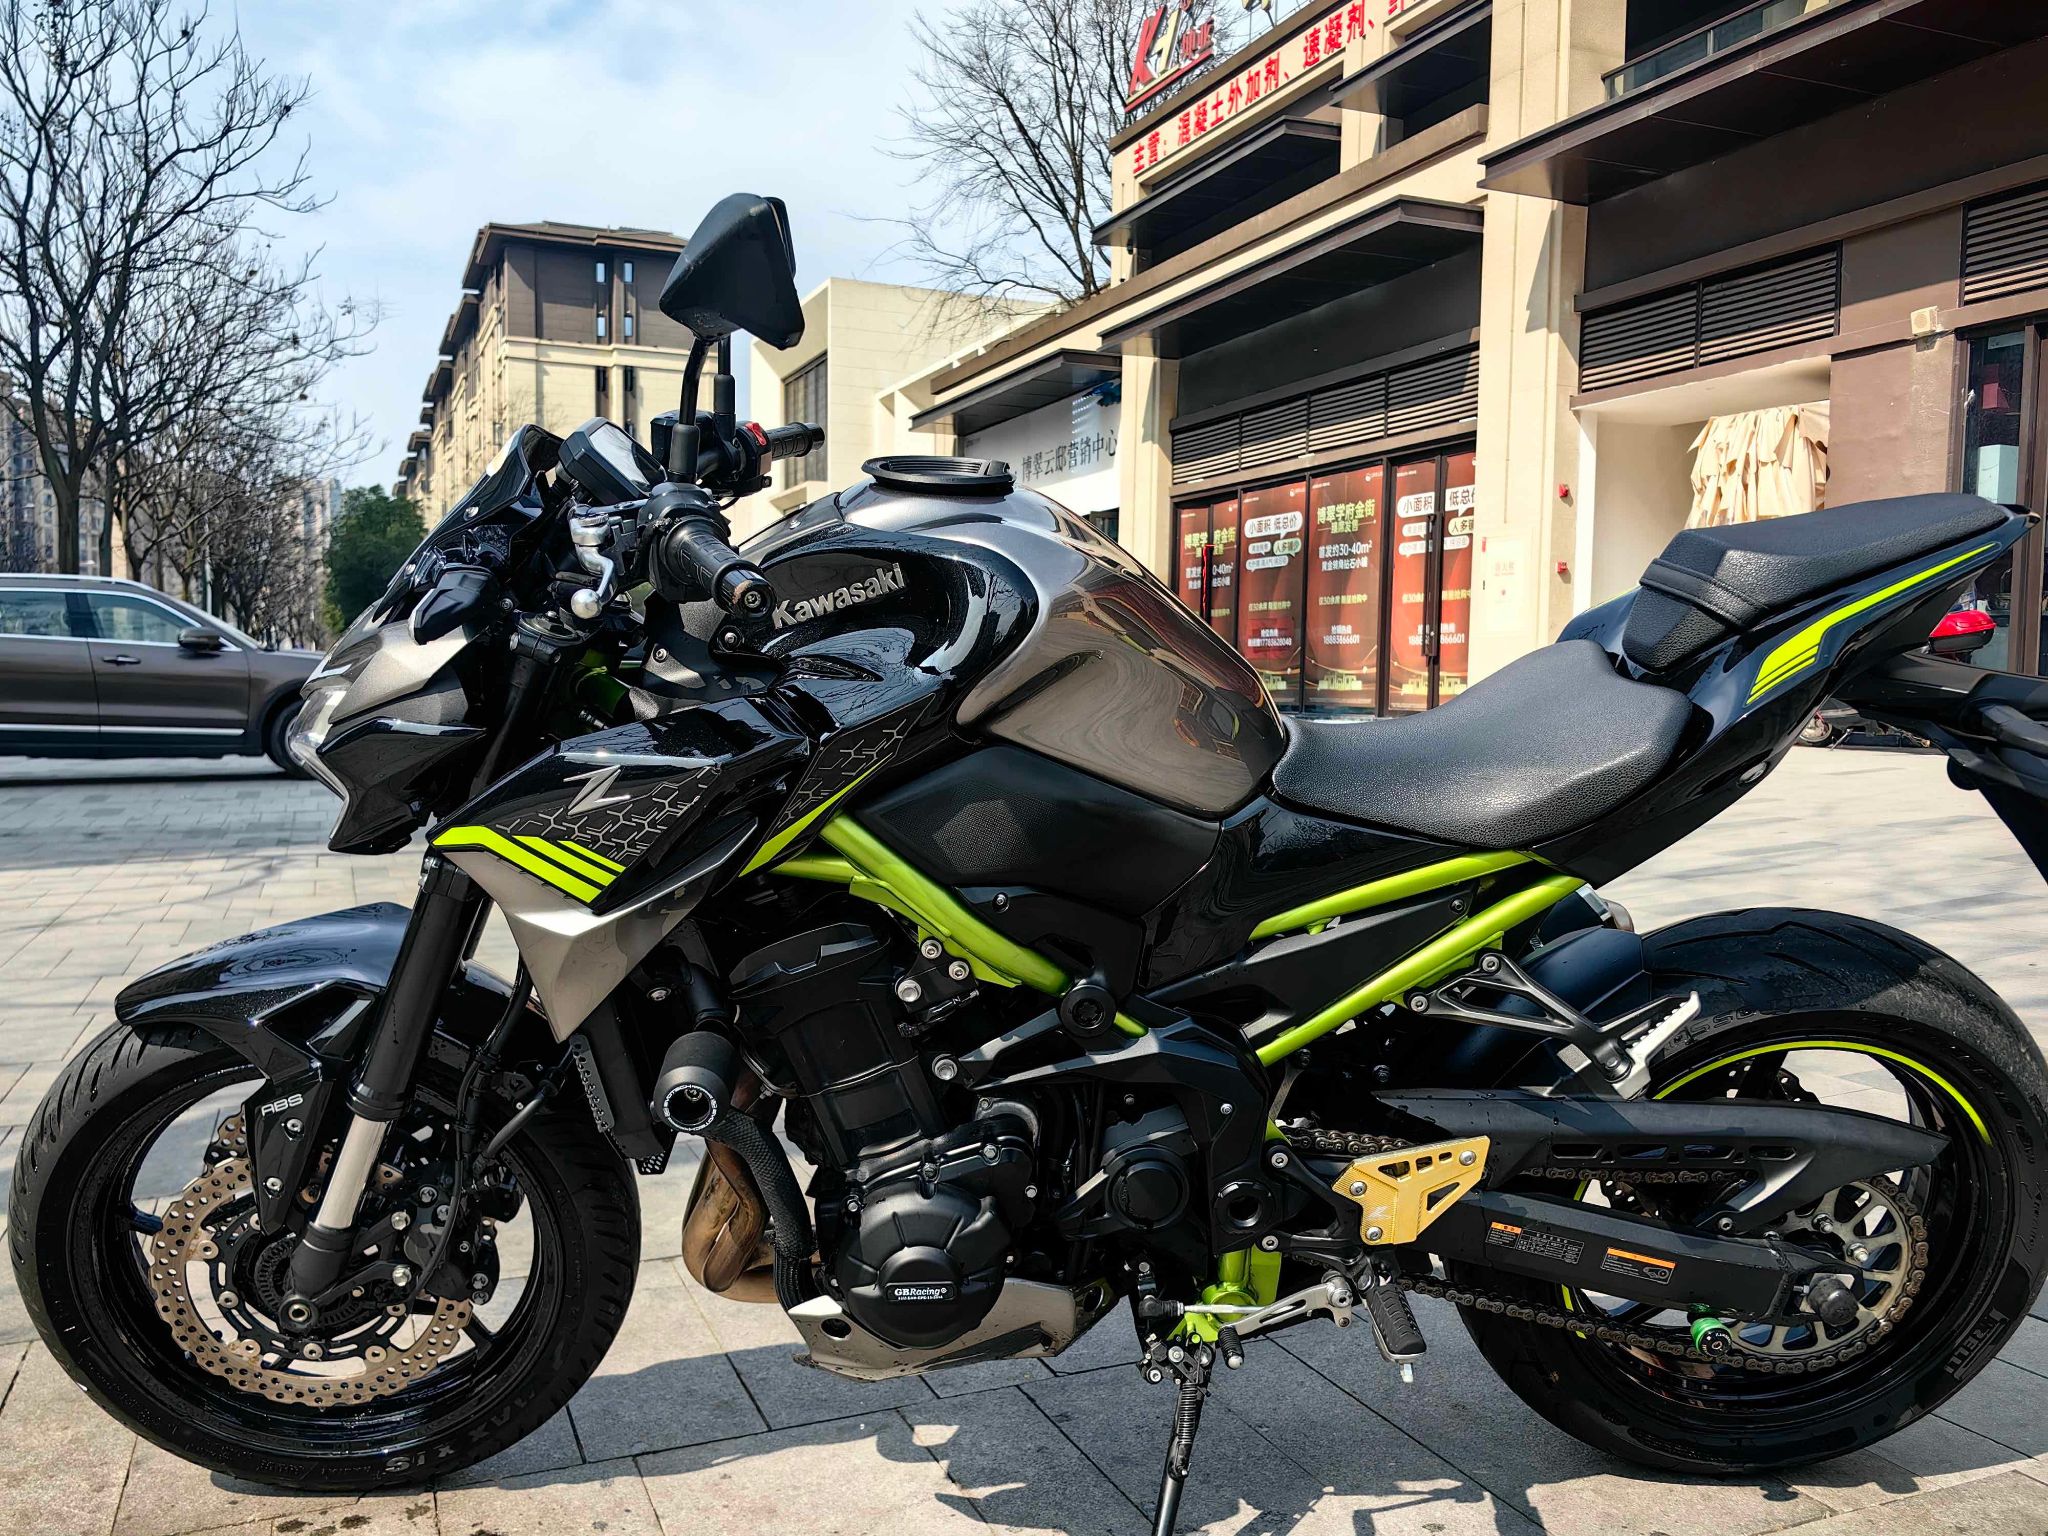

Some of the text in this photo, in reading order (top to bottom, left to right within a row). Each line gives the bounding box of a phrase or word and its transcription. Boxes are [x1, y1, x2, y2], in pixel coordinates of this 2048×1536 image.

[1403, 496, 1433, 514] 小面积
[772, 562, 906, 630] Kawasaki
[261, 1093, 304, 1117] ABS
